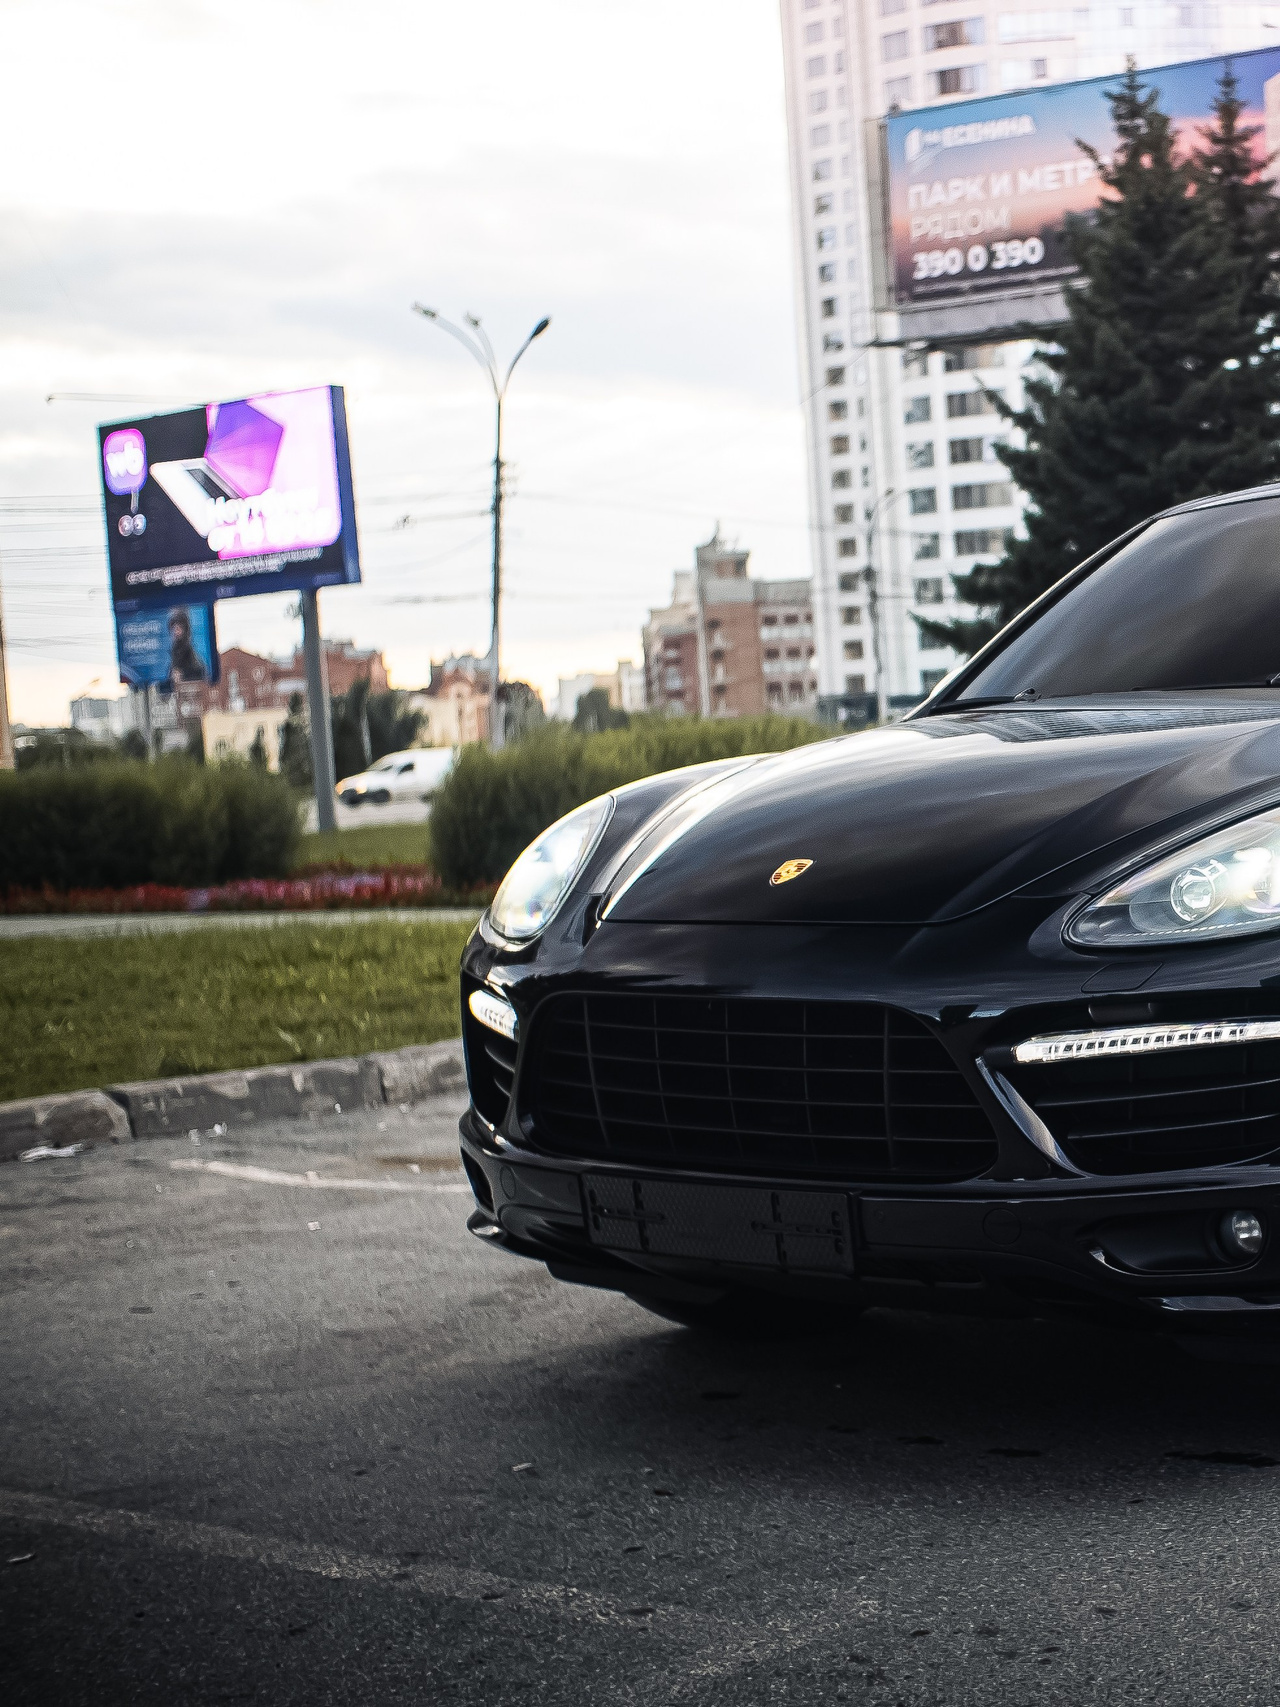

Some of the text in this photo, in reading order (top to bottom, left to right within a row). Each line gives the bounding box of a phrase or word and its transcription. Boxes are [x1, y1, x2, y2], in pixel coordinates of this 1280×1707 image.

[907, 176, 984, 211] ПАРК
[990, 173, 1012, 198] И
[910, 207, 1010, 241] РЯДОМ
[912, 247, 965, 281] 390
[991, 236, 1045, 270] 390
